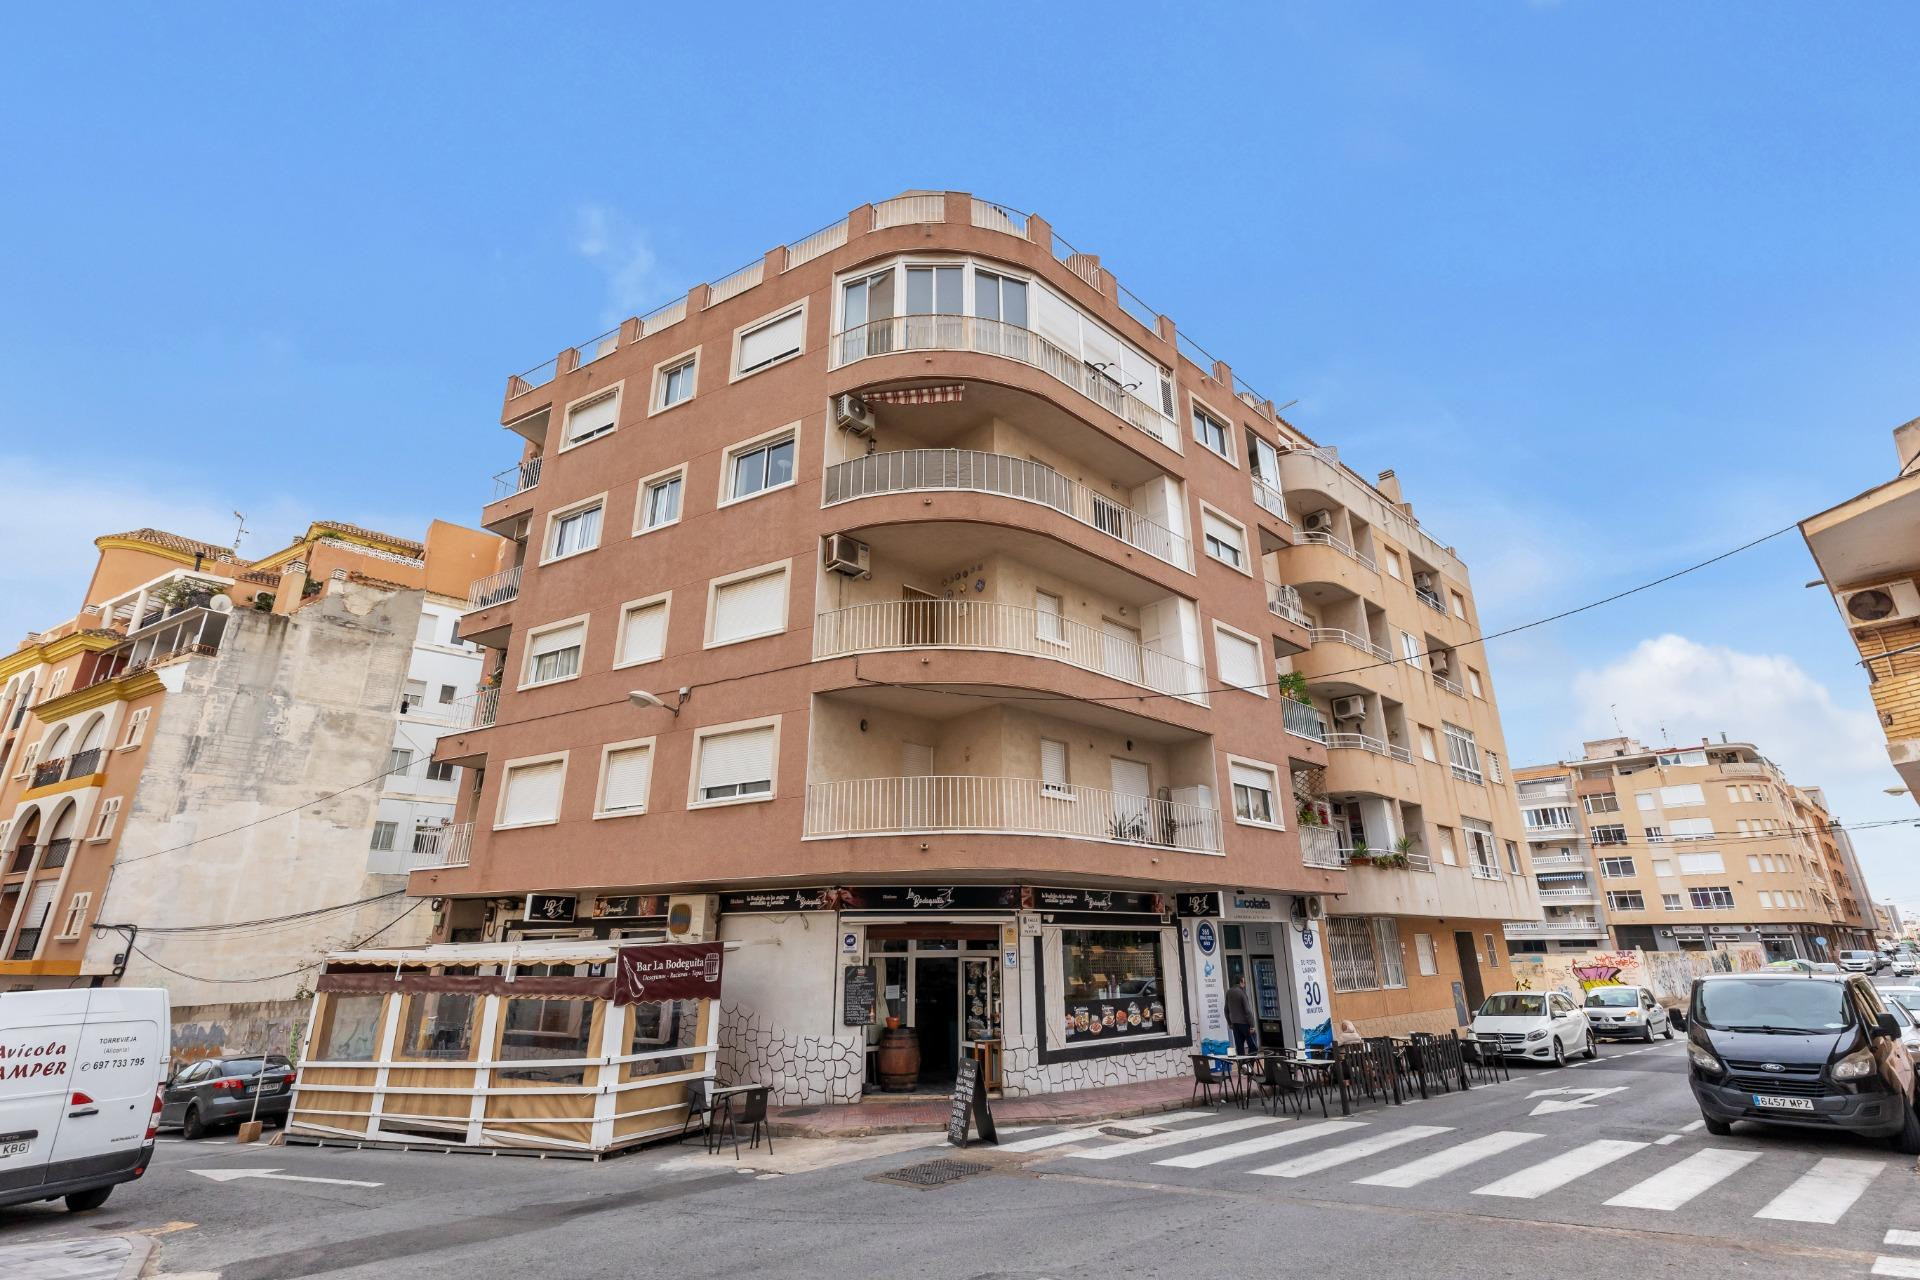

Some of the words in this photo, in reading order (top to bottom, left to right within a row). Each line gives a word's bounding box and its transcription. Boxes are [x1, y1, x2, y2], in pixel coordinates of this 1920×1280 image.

[636, 961, 652, 972] Bar
[653, 960, 664, 971] La
[665, 958, 704, 971] Bodeguita
[1304, 981, 1322, 1006] 30
[93, 1060, 110, 1070] 697
[112, 1058, 128, 1068] 733
[130, 1057, 145, 1067] 795
[1760, 1097, 1786, 1107] 6457
[1789, 1099, 1811, 1109] MPZ
[3, 1142, 26, 1154] KBG
